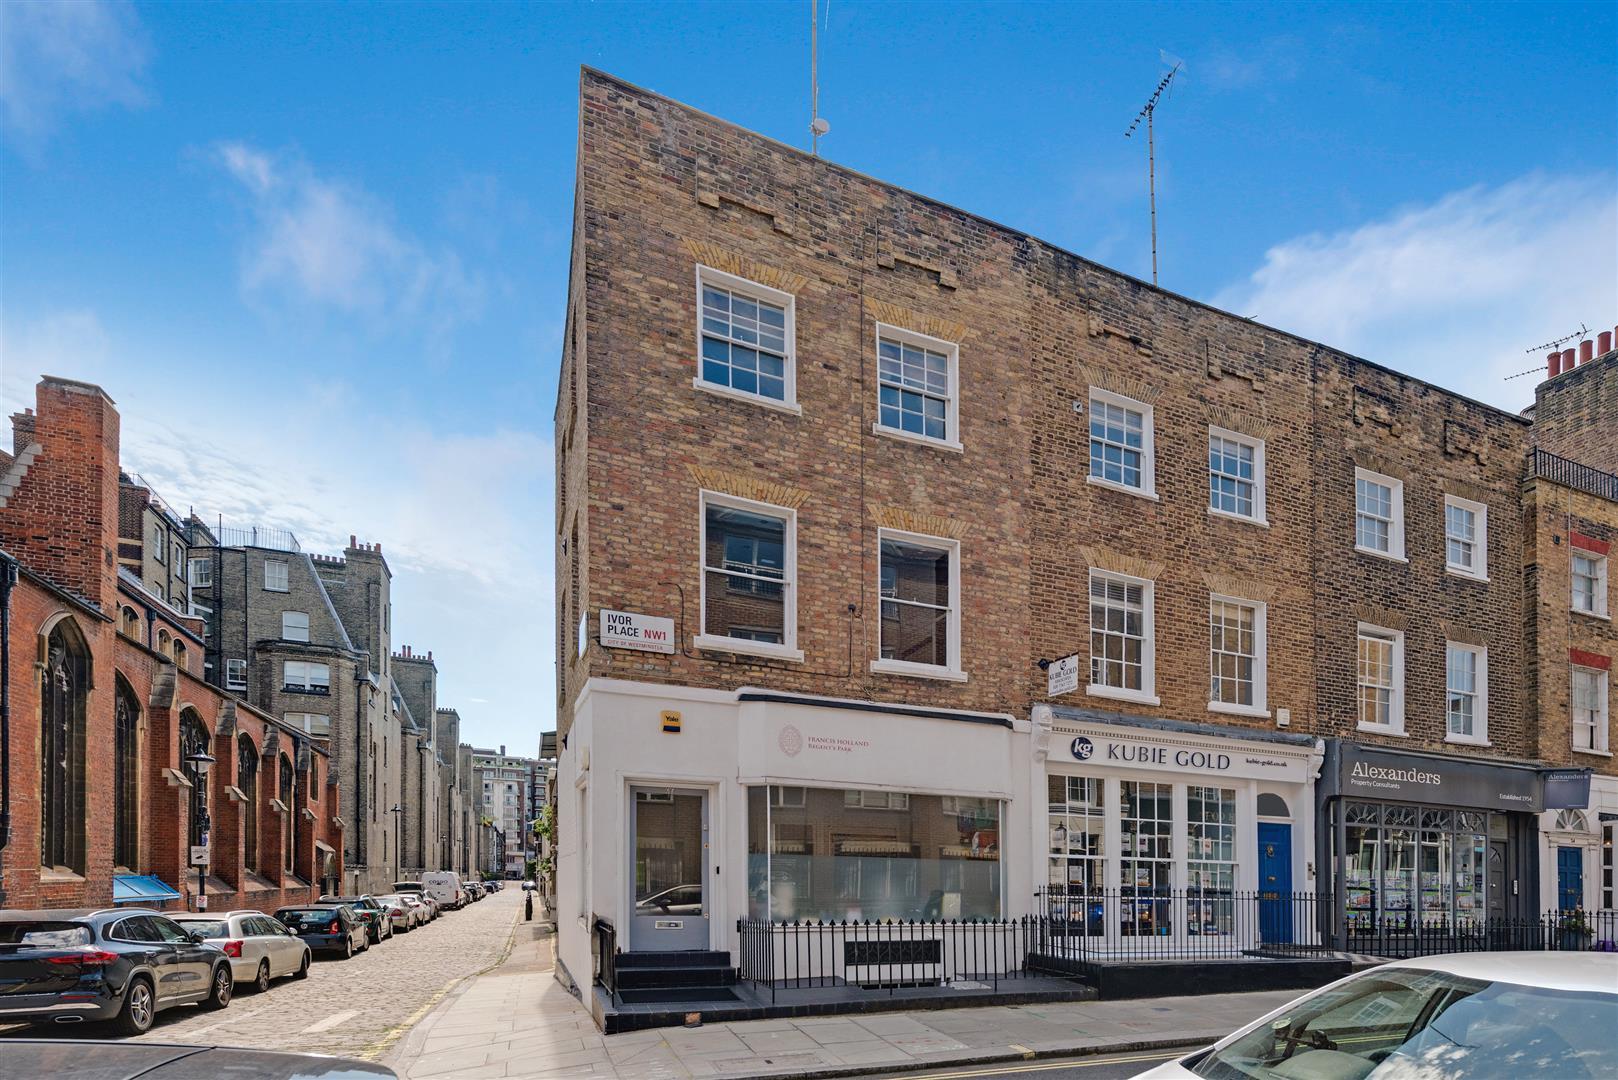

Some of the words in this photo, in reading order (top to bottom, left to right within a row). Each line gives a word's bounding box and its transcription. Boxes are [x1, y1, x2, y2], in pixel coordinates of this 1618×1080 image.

[607, 614, 632, 625] IVOR
[607, 625, 639, 637] PLACE
[644, 629, 667, 641] NW1
[628, 641, 663, 650] WESTMINSTER
[807, 736, 836, 744] FRANCIS
[837, 739, 870, 748] HOLLAND
[1107, 743, 1168, 765] KUBIE
[1175, 750, 1231, 770] GOLD
[1351, 761, 1441, 785] Alexanders
[1350, 778, 1372, 788] Property
[1372, 780, 1401, 790] Consultants
[1499, 793, 1522, 802] Established
